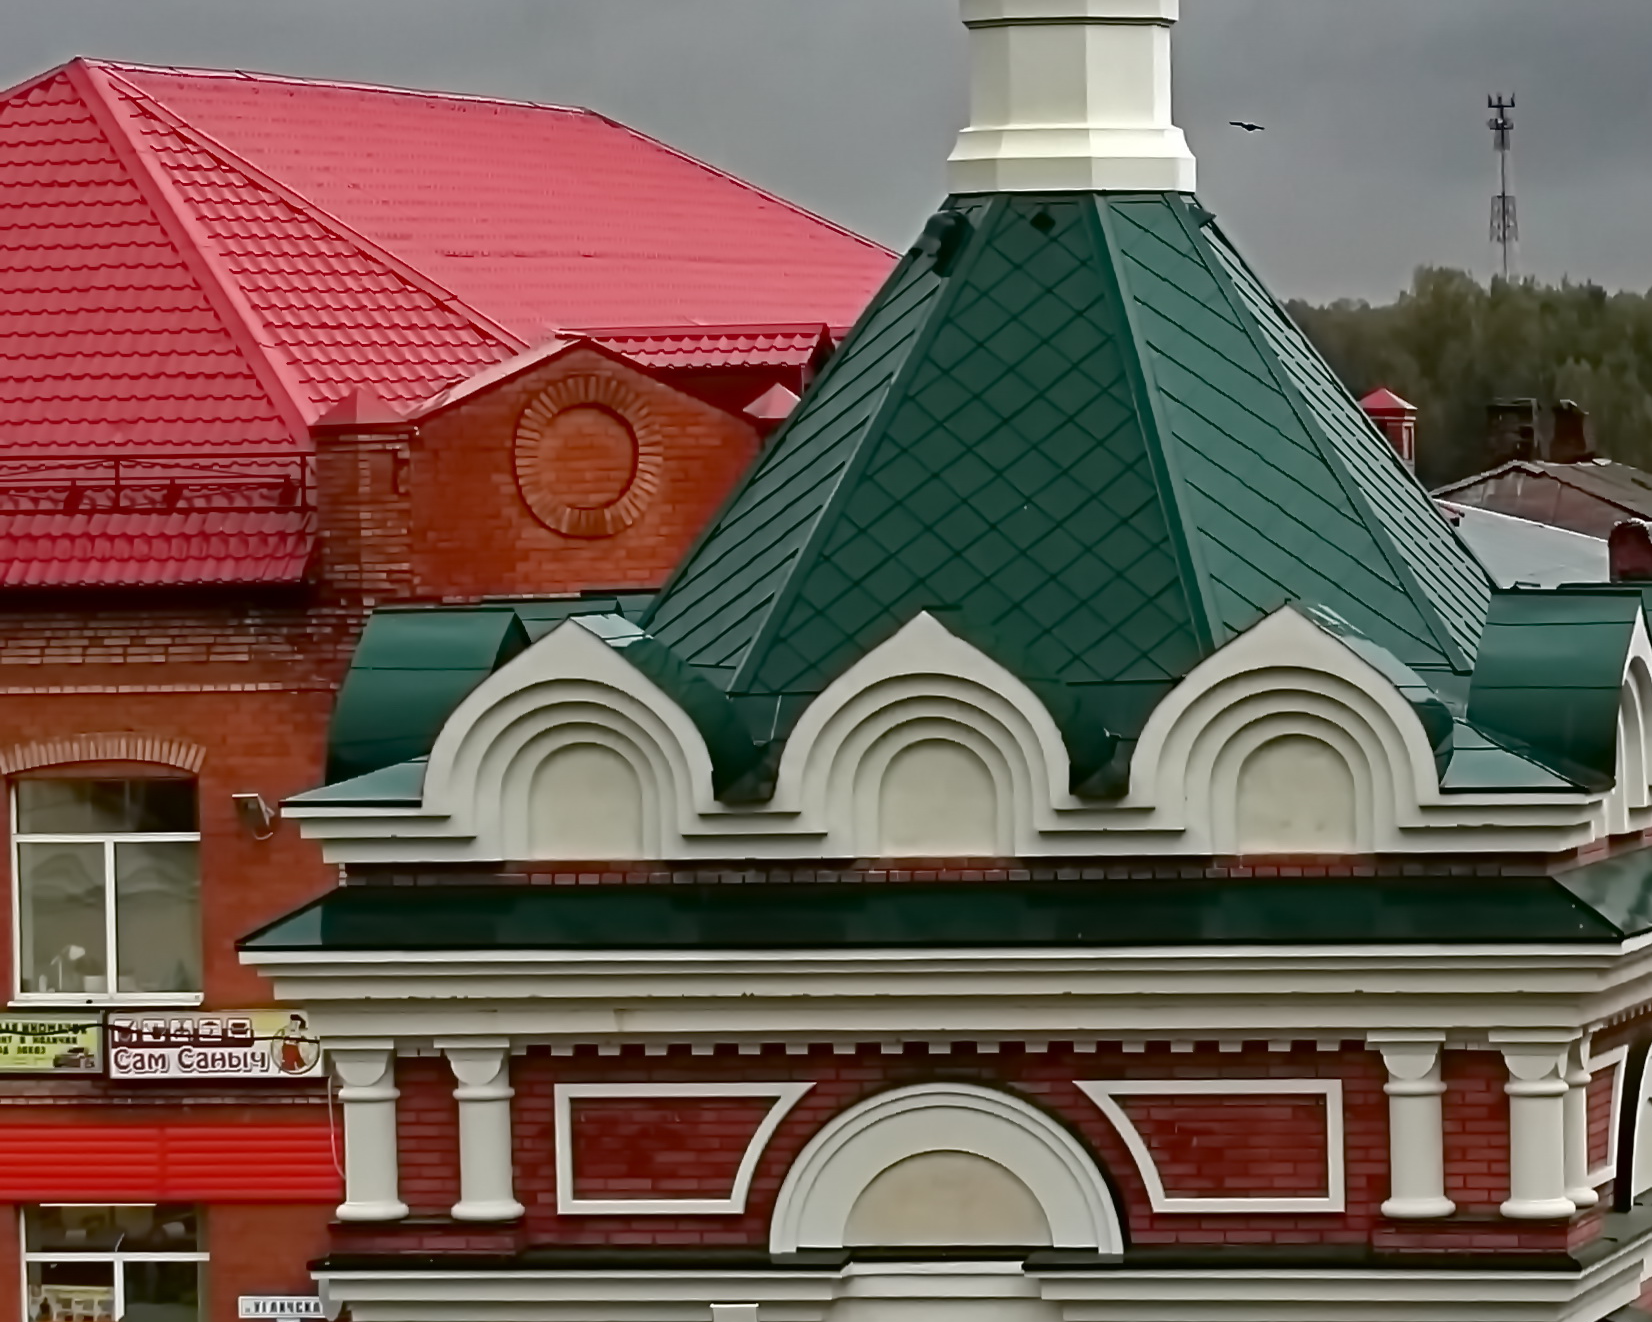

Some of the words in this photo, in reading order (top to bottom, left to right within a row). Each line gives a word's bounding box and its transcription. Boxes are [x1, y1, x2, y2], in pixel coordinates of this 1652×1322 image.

[113, 1047, 167, 1071] Сам
[177, 1047, 266, 1070] Саныч
[253, 1301, 321, 1314] УГЛИЧСКА
